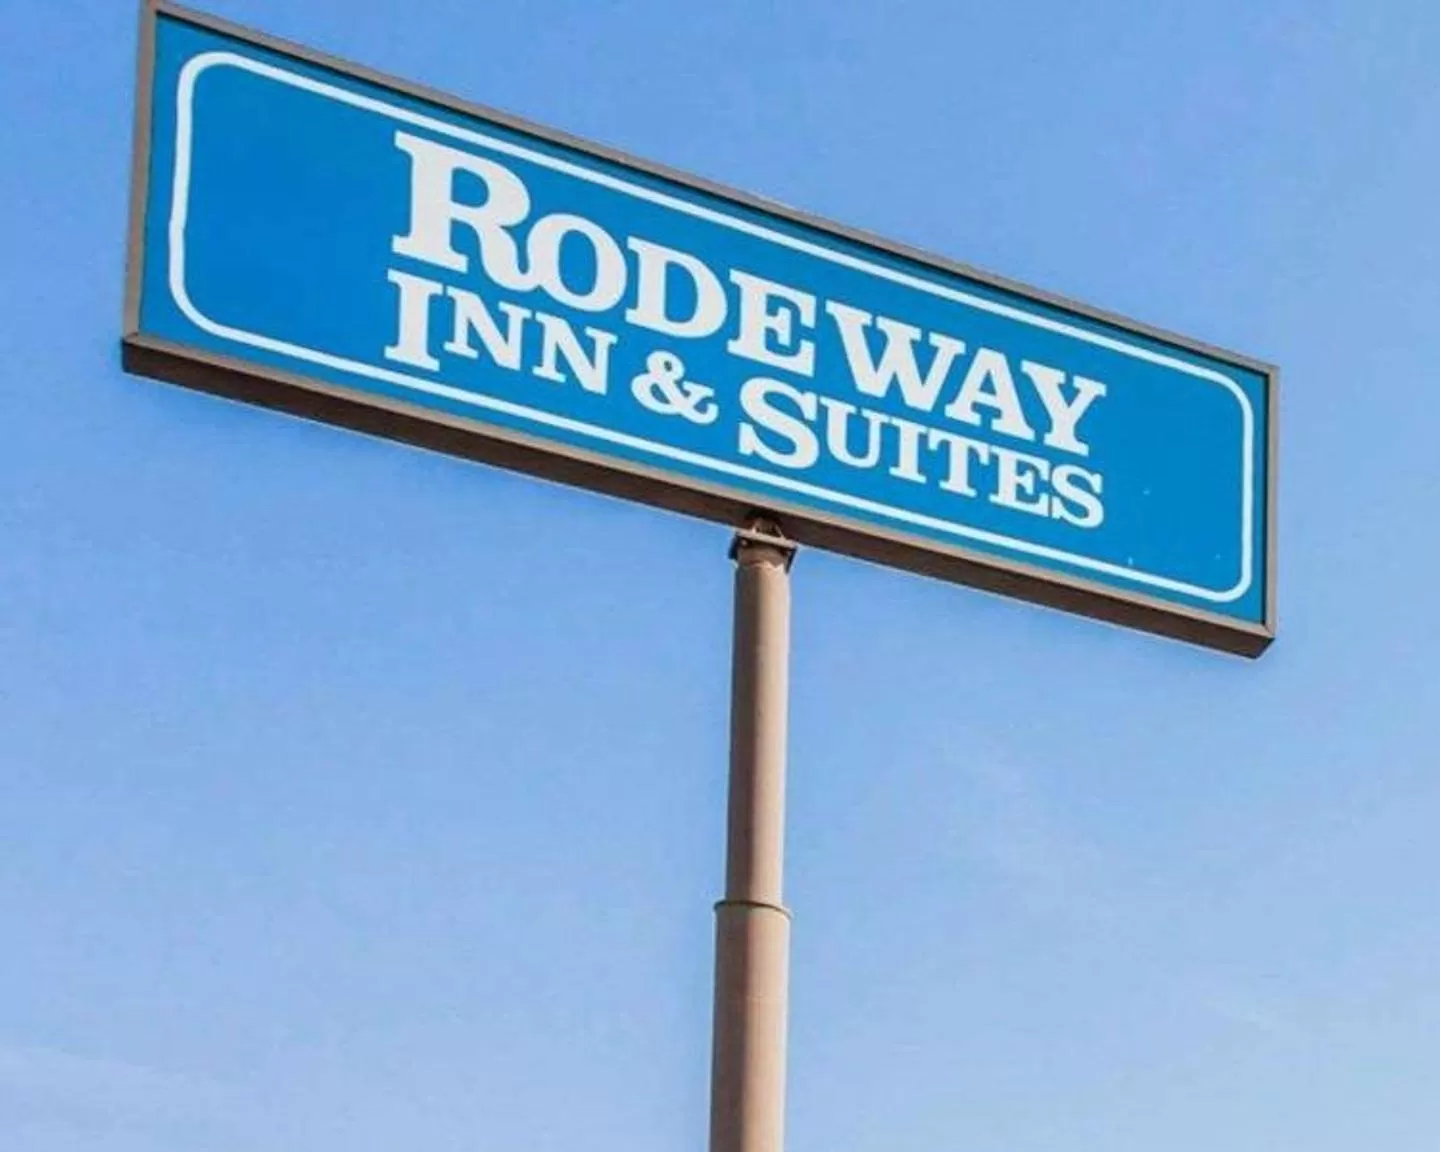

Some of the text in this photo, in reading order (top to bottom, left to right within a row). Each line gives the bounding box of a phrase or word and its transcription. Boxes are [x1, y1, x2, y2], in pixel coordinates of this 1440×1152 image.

[385, 271, 1104, 527] INN & SUITES
[394, 132, 1105, 455] RODEWAY
